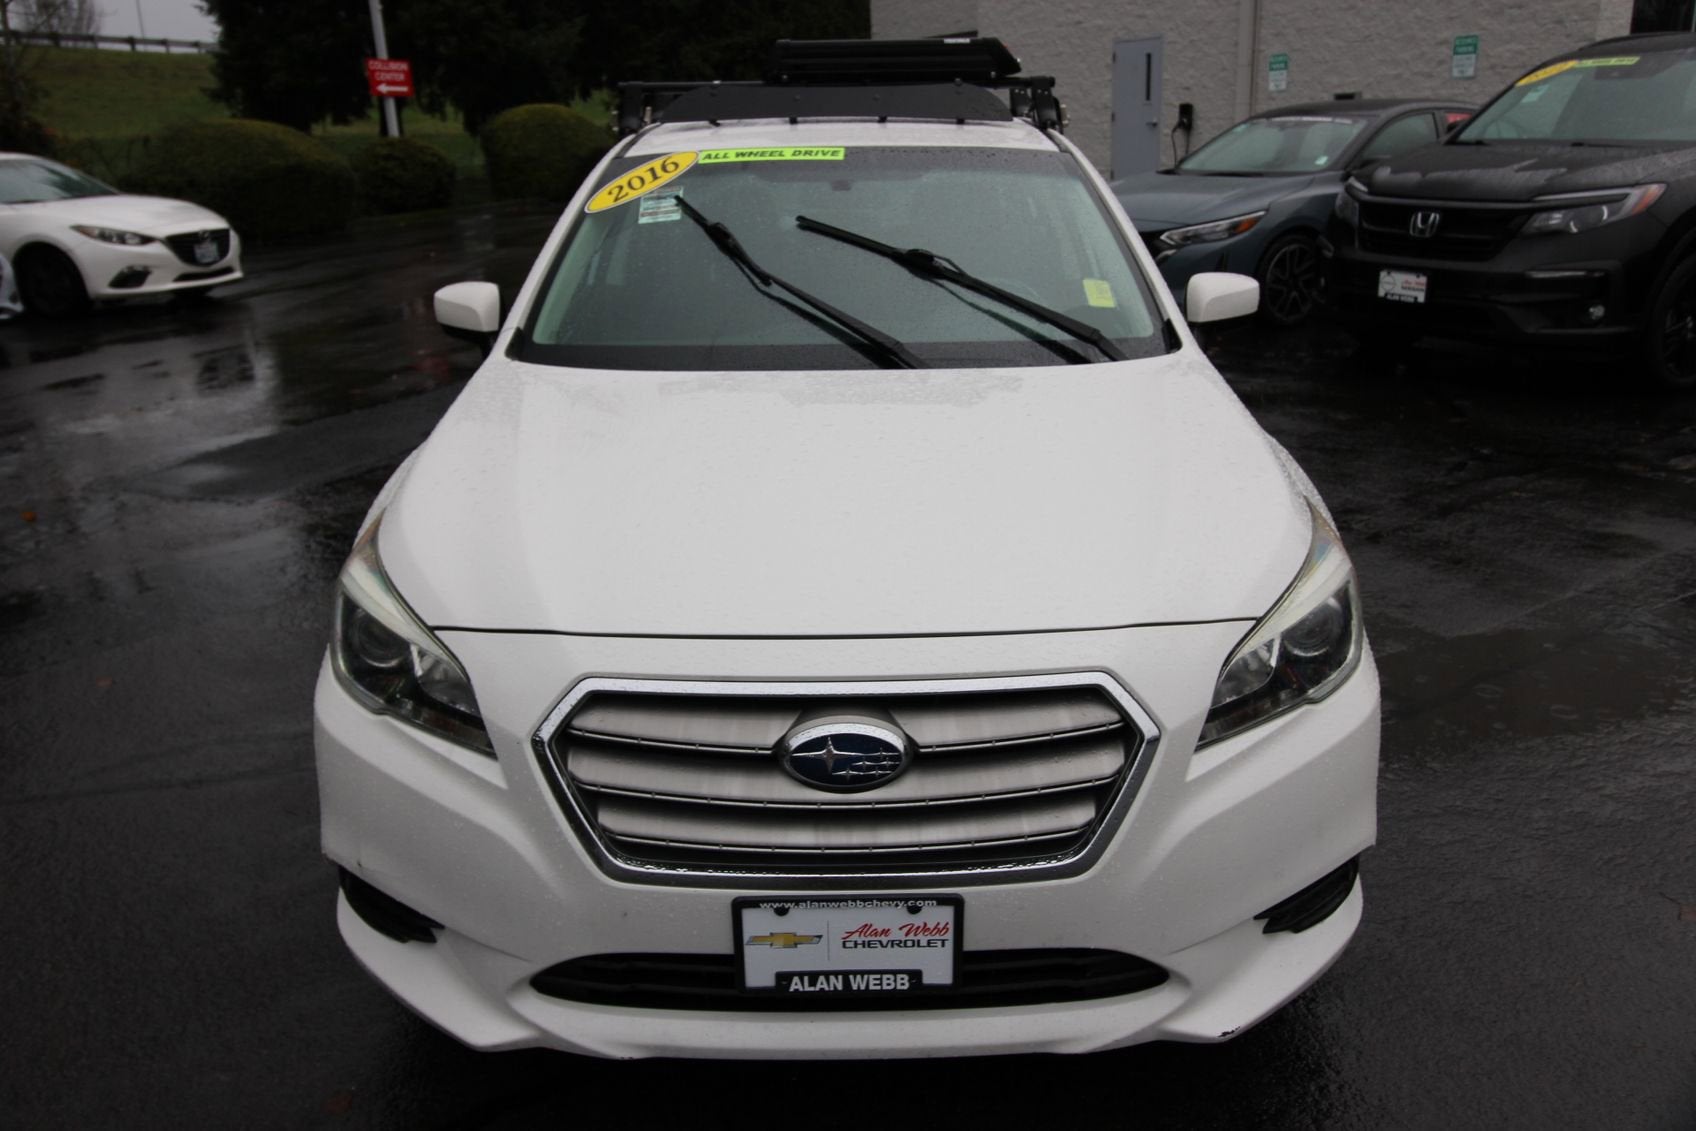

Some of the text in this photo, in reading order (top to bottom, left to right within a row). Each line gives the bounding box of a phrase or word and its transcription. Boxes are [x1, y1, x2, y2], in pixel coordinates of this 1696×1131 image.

[703, 148, 840, 160] ALL WHEEL DRIVE
[608, 156, 680, 202] 2016
[760, 899, 937, 909] www.alanwebbchevy.com
[841, 921, 950, 940] Alan Webb
[842, 938, 950, 949] CHEVROLET
[789, 974, 910, 992] ALAN WEBB
